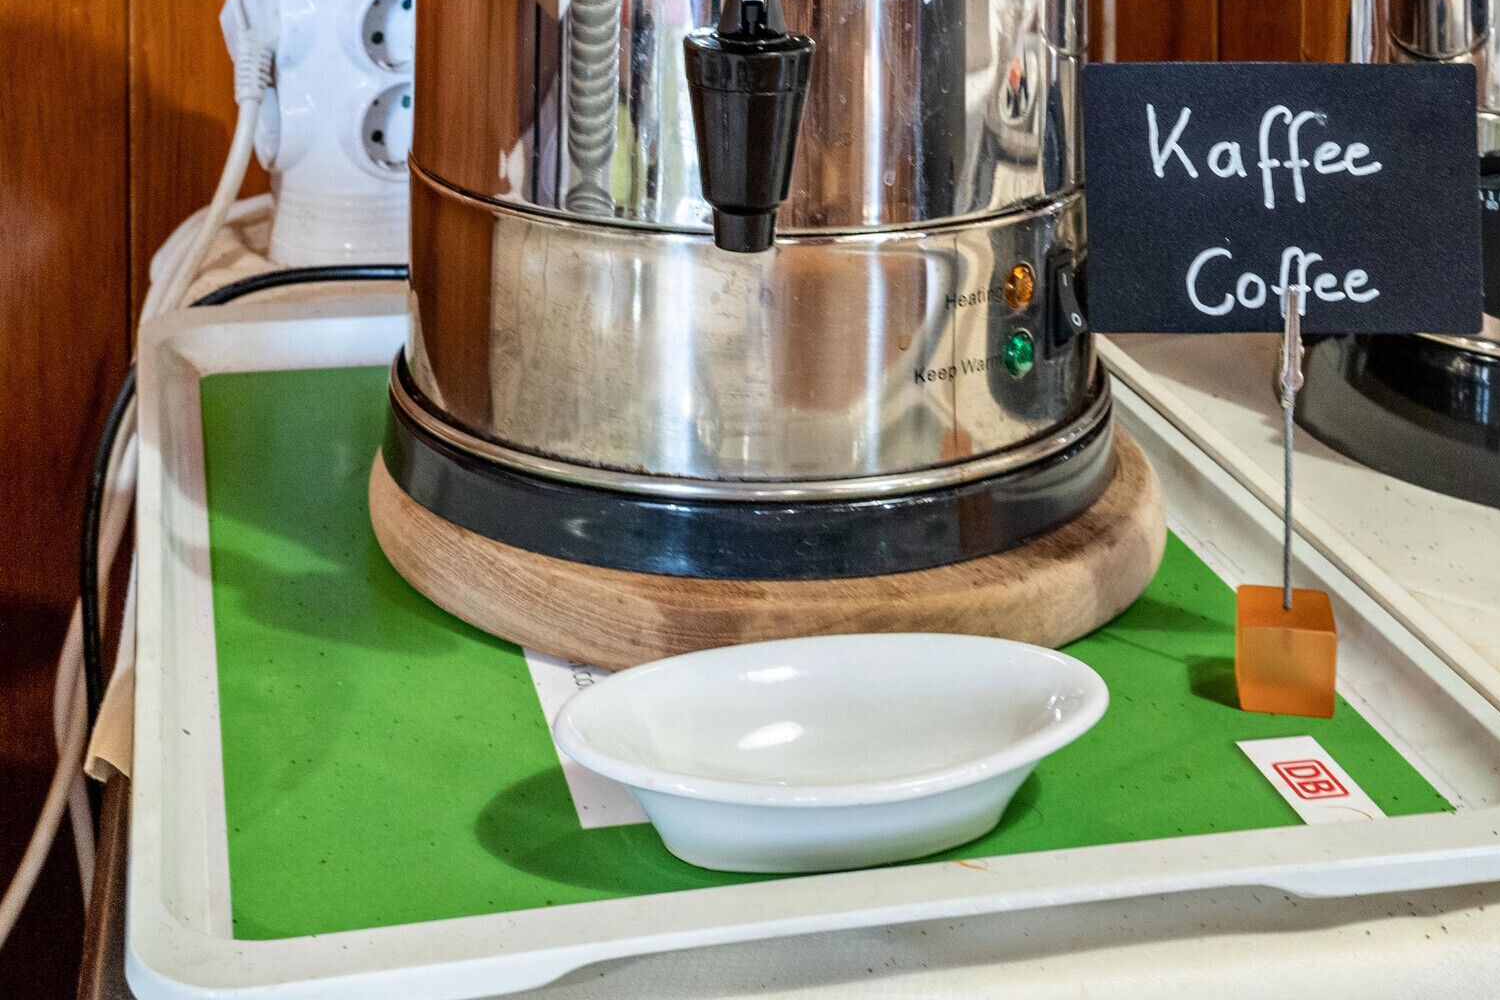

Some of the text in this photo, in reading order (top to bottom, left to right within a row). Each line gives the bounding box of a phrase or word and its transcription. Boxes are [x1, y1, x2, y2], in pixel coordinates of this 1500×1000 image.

[1146, 102, 1383, 210] Kaffee
[1185, 246, 1381, 318] Coffee
[914, 364, 958, 385] Keep
[1282, 764, 1336, 795] DB
